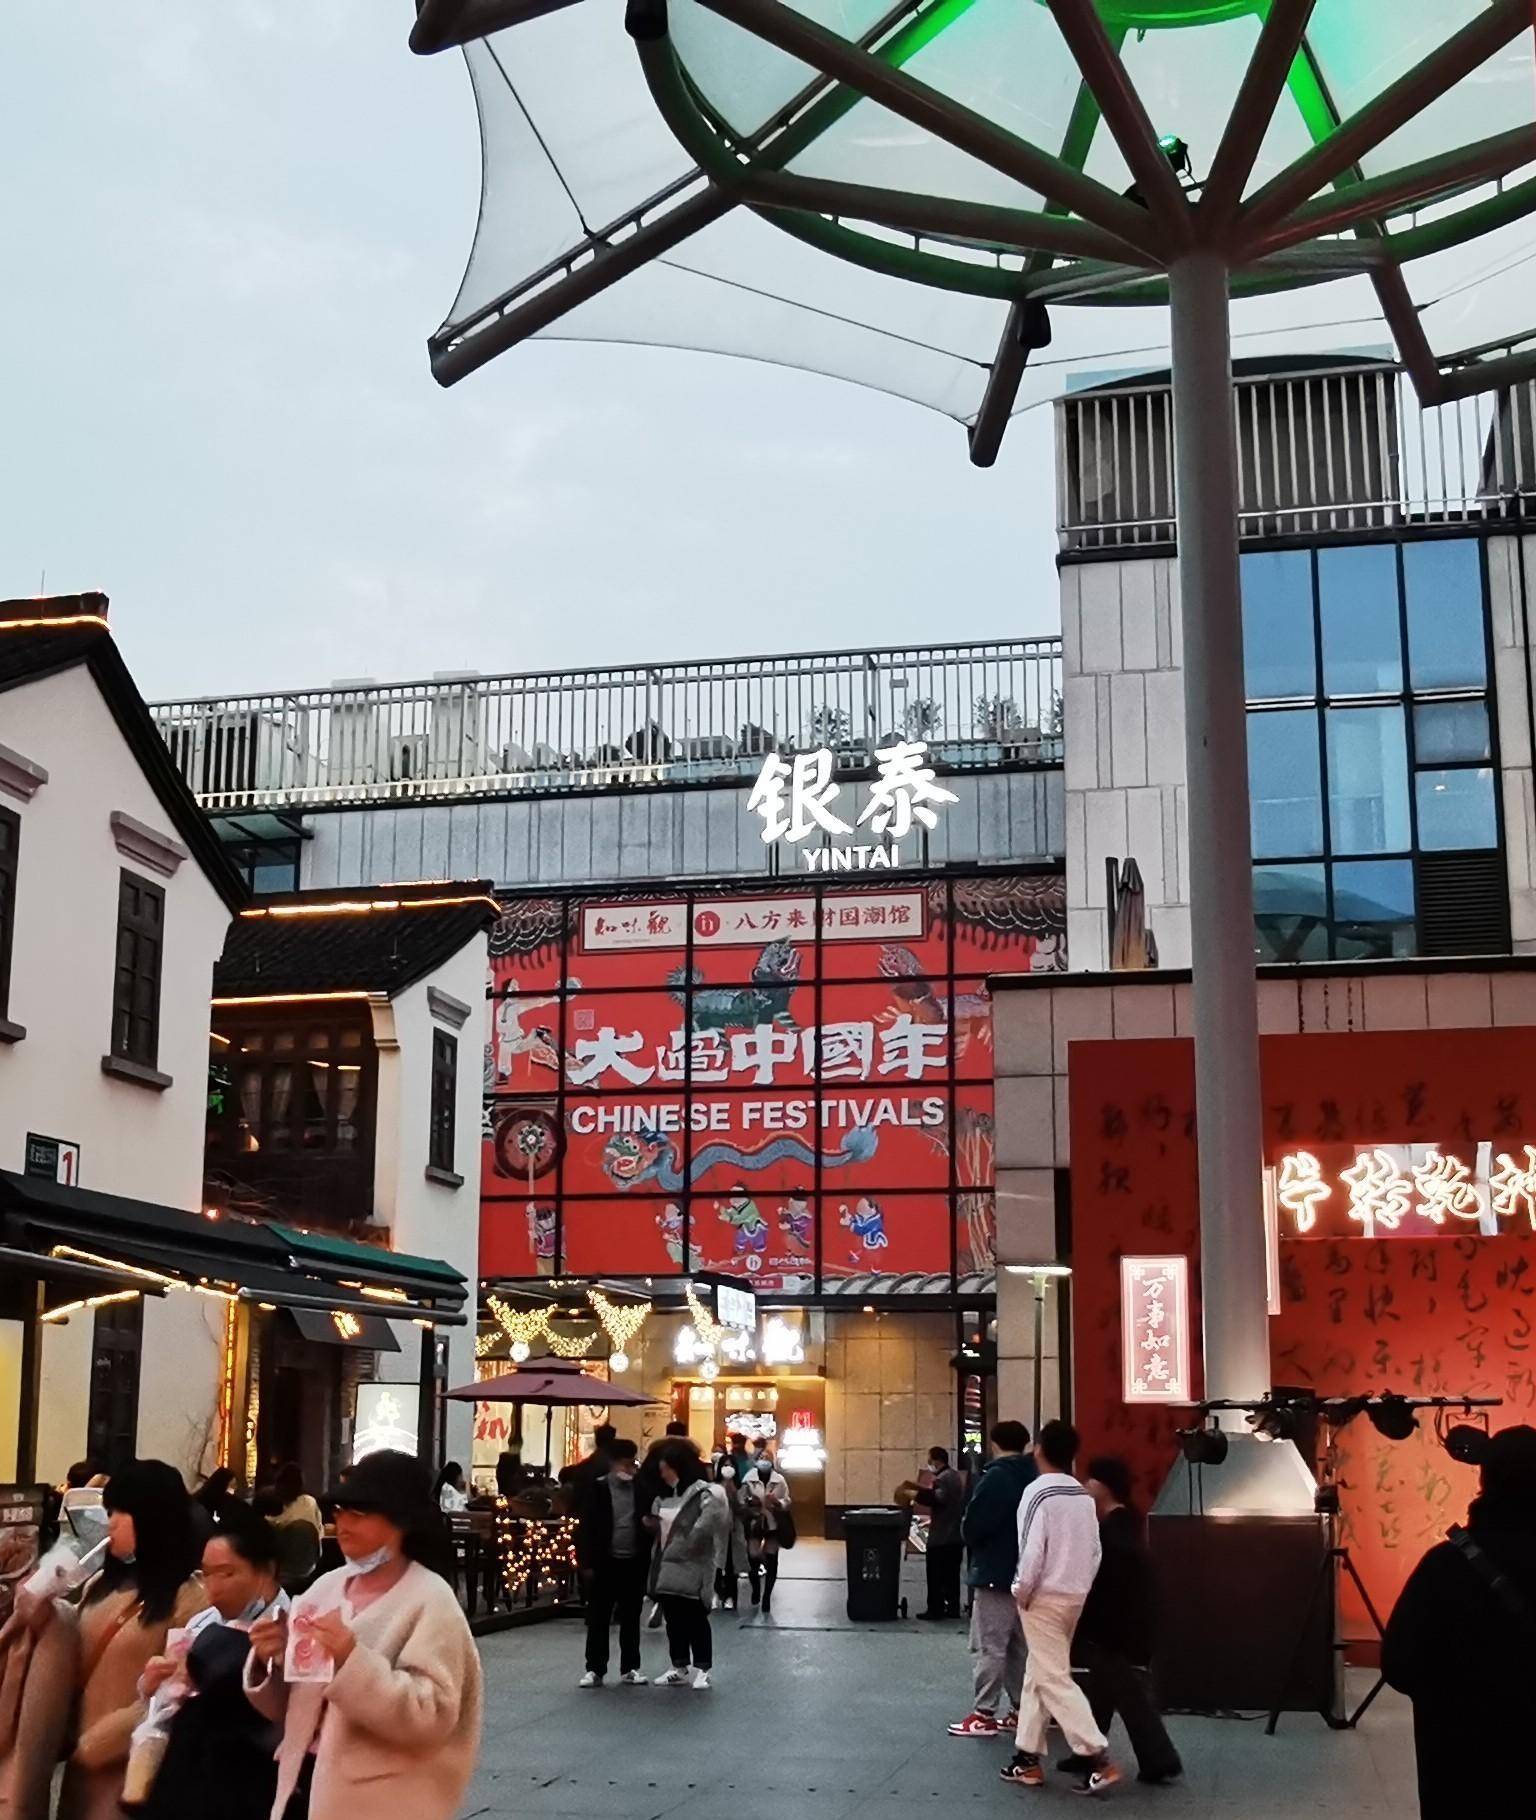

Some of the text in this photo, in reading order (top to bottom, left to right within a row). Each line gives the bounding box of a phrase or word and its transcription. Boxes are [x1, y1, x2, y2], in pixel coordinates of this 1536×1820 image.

[747, 741, 961, 843] 银泰
[802, 845, 900, 872] YINTAI
[571, 1096, 946, 1134] CHINESE FESTIVALS
